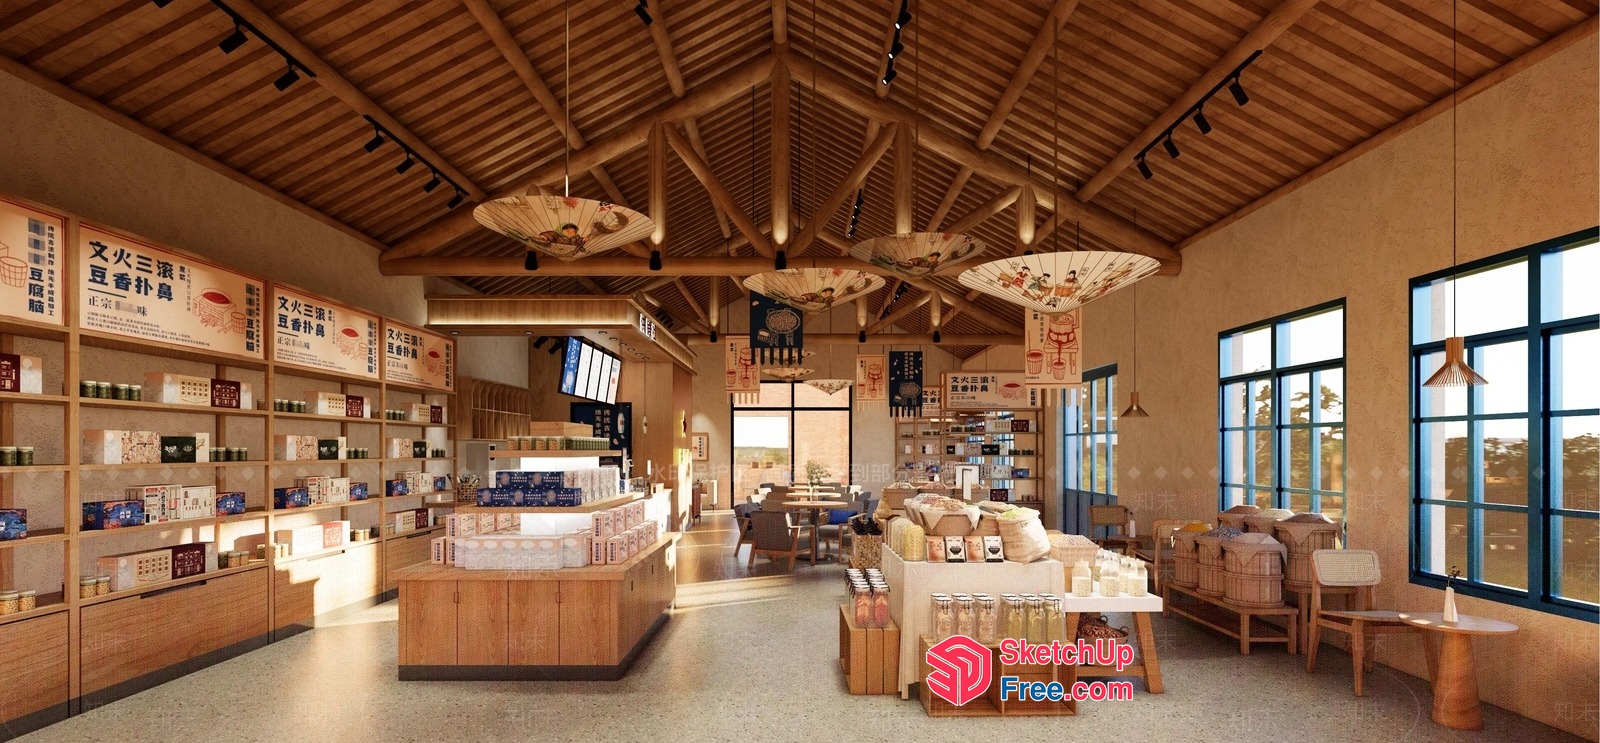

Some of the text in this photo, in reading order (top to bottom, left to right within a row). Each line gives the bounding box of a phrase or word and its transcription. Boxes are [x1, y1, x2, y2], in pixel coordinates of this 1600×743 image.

[88, 240, 174, 281] 文火三滚
[28, 267, 44, 314] 豆腐脑
[88, 264, 174, 302] 豆香扑鼻
[88, 295, 148, 316] 正宗 味
[277, 296, 326, 322] 文火三滚
[277, 313, 326, 338] 豆香扑鼻
[277, 336, 291, 347] 正宗
[387, 328, 419, 347] 文火三滚
[387, 342, 418, 360] 豆香扑鼻
[950, 376, 989, 384] 文火三滚
[950, 384, 989, 392] 豆香扑鼻
